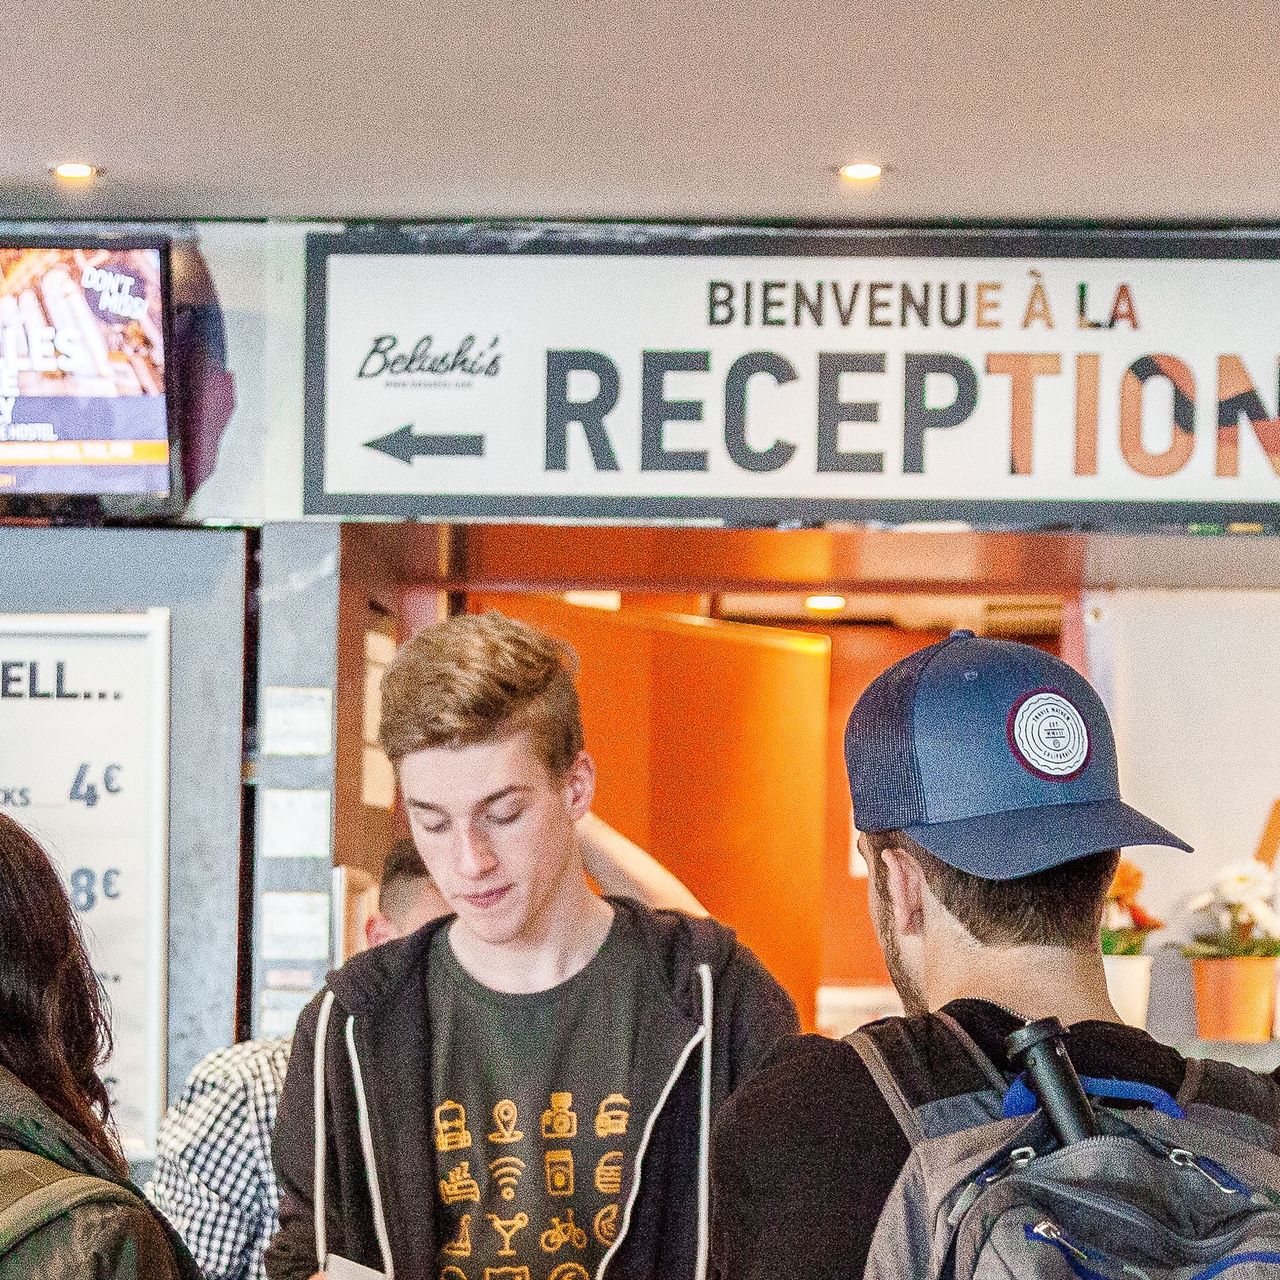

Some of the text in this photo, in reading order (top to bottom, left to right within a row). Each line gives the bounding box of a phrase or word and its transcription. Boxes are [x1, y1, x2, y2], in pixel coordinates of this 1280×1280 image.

[708, 271, 1140, 330] BIENVENUE À LA
[356, 333, 503, 380] Belushi's
